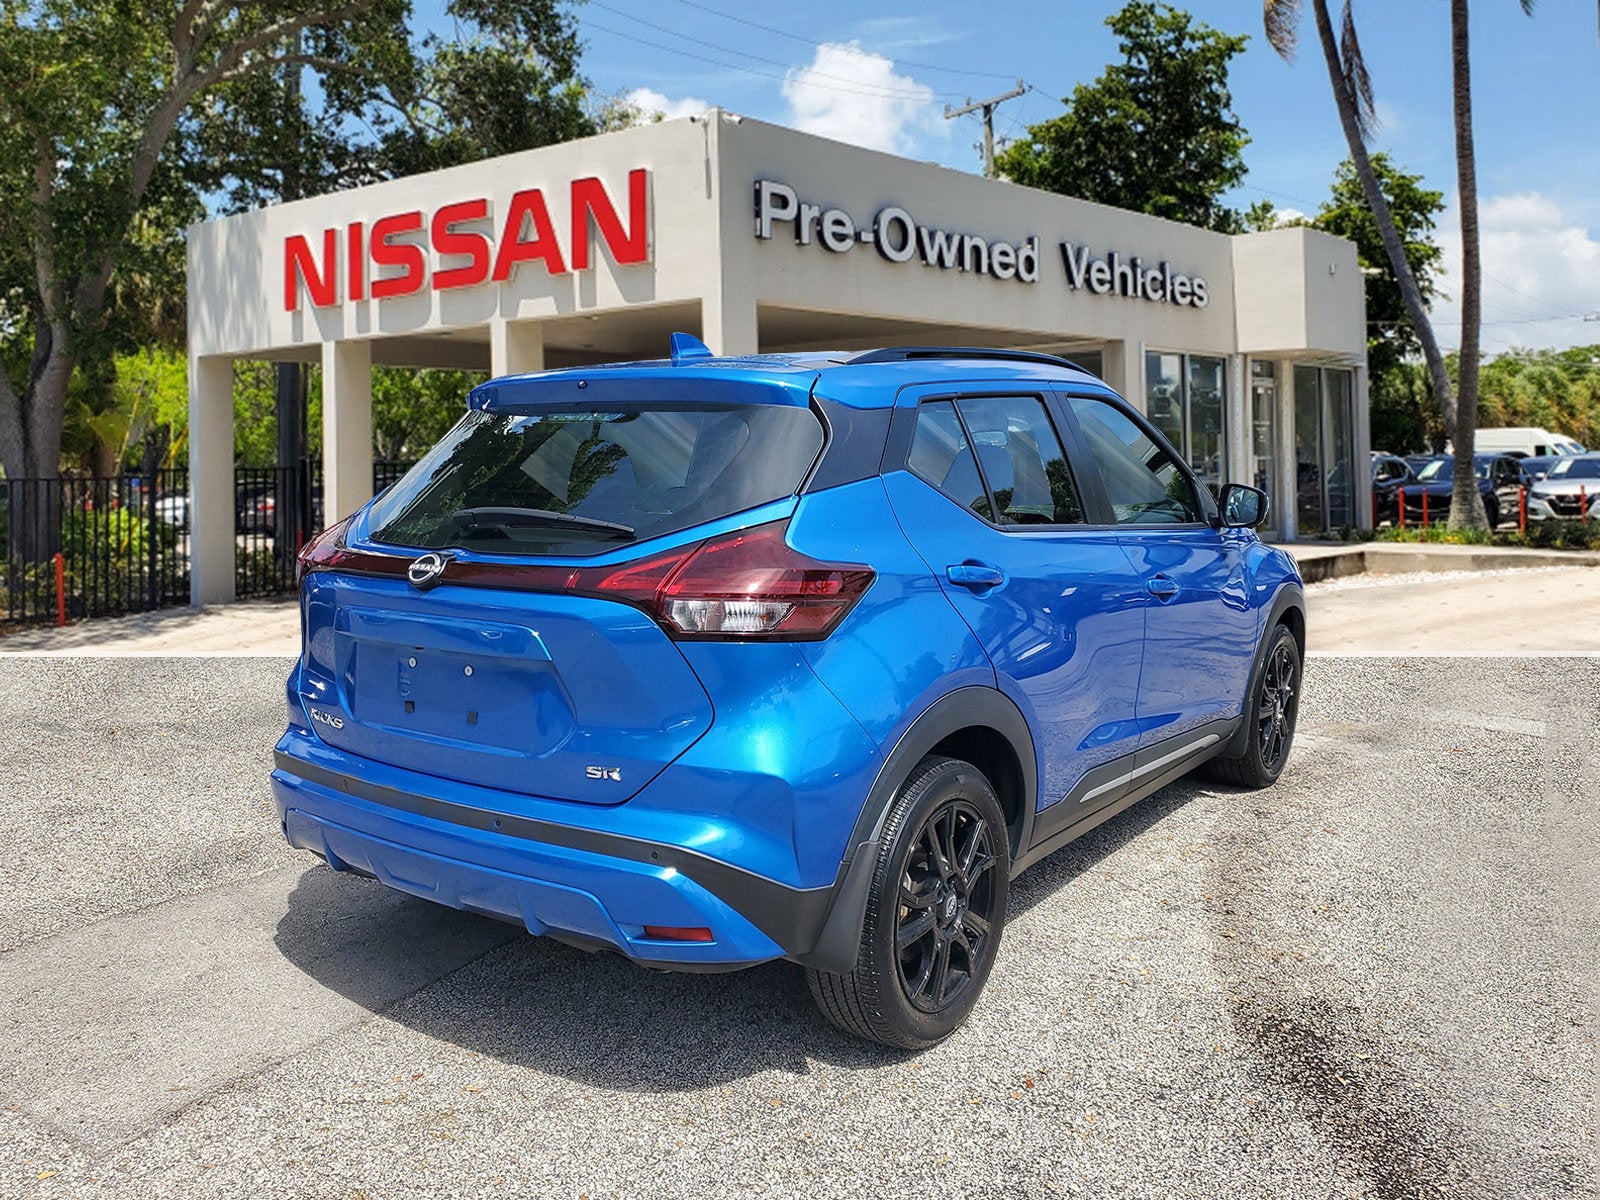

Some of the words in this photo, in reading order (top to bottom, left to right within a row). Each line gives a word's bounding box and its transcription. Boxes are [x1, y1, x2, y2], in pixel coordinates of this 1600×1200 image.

[284, 167, 648, 311] NISSAN
[754, 180, 1040, 284] Pre-Owned
[1060, 241, 1208, 308] Vehicles
[409, 563, 441, 573] NISSAN
[310, 707, 345, 729] KICKS
[585, 766, 621, 782] SR
